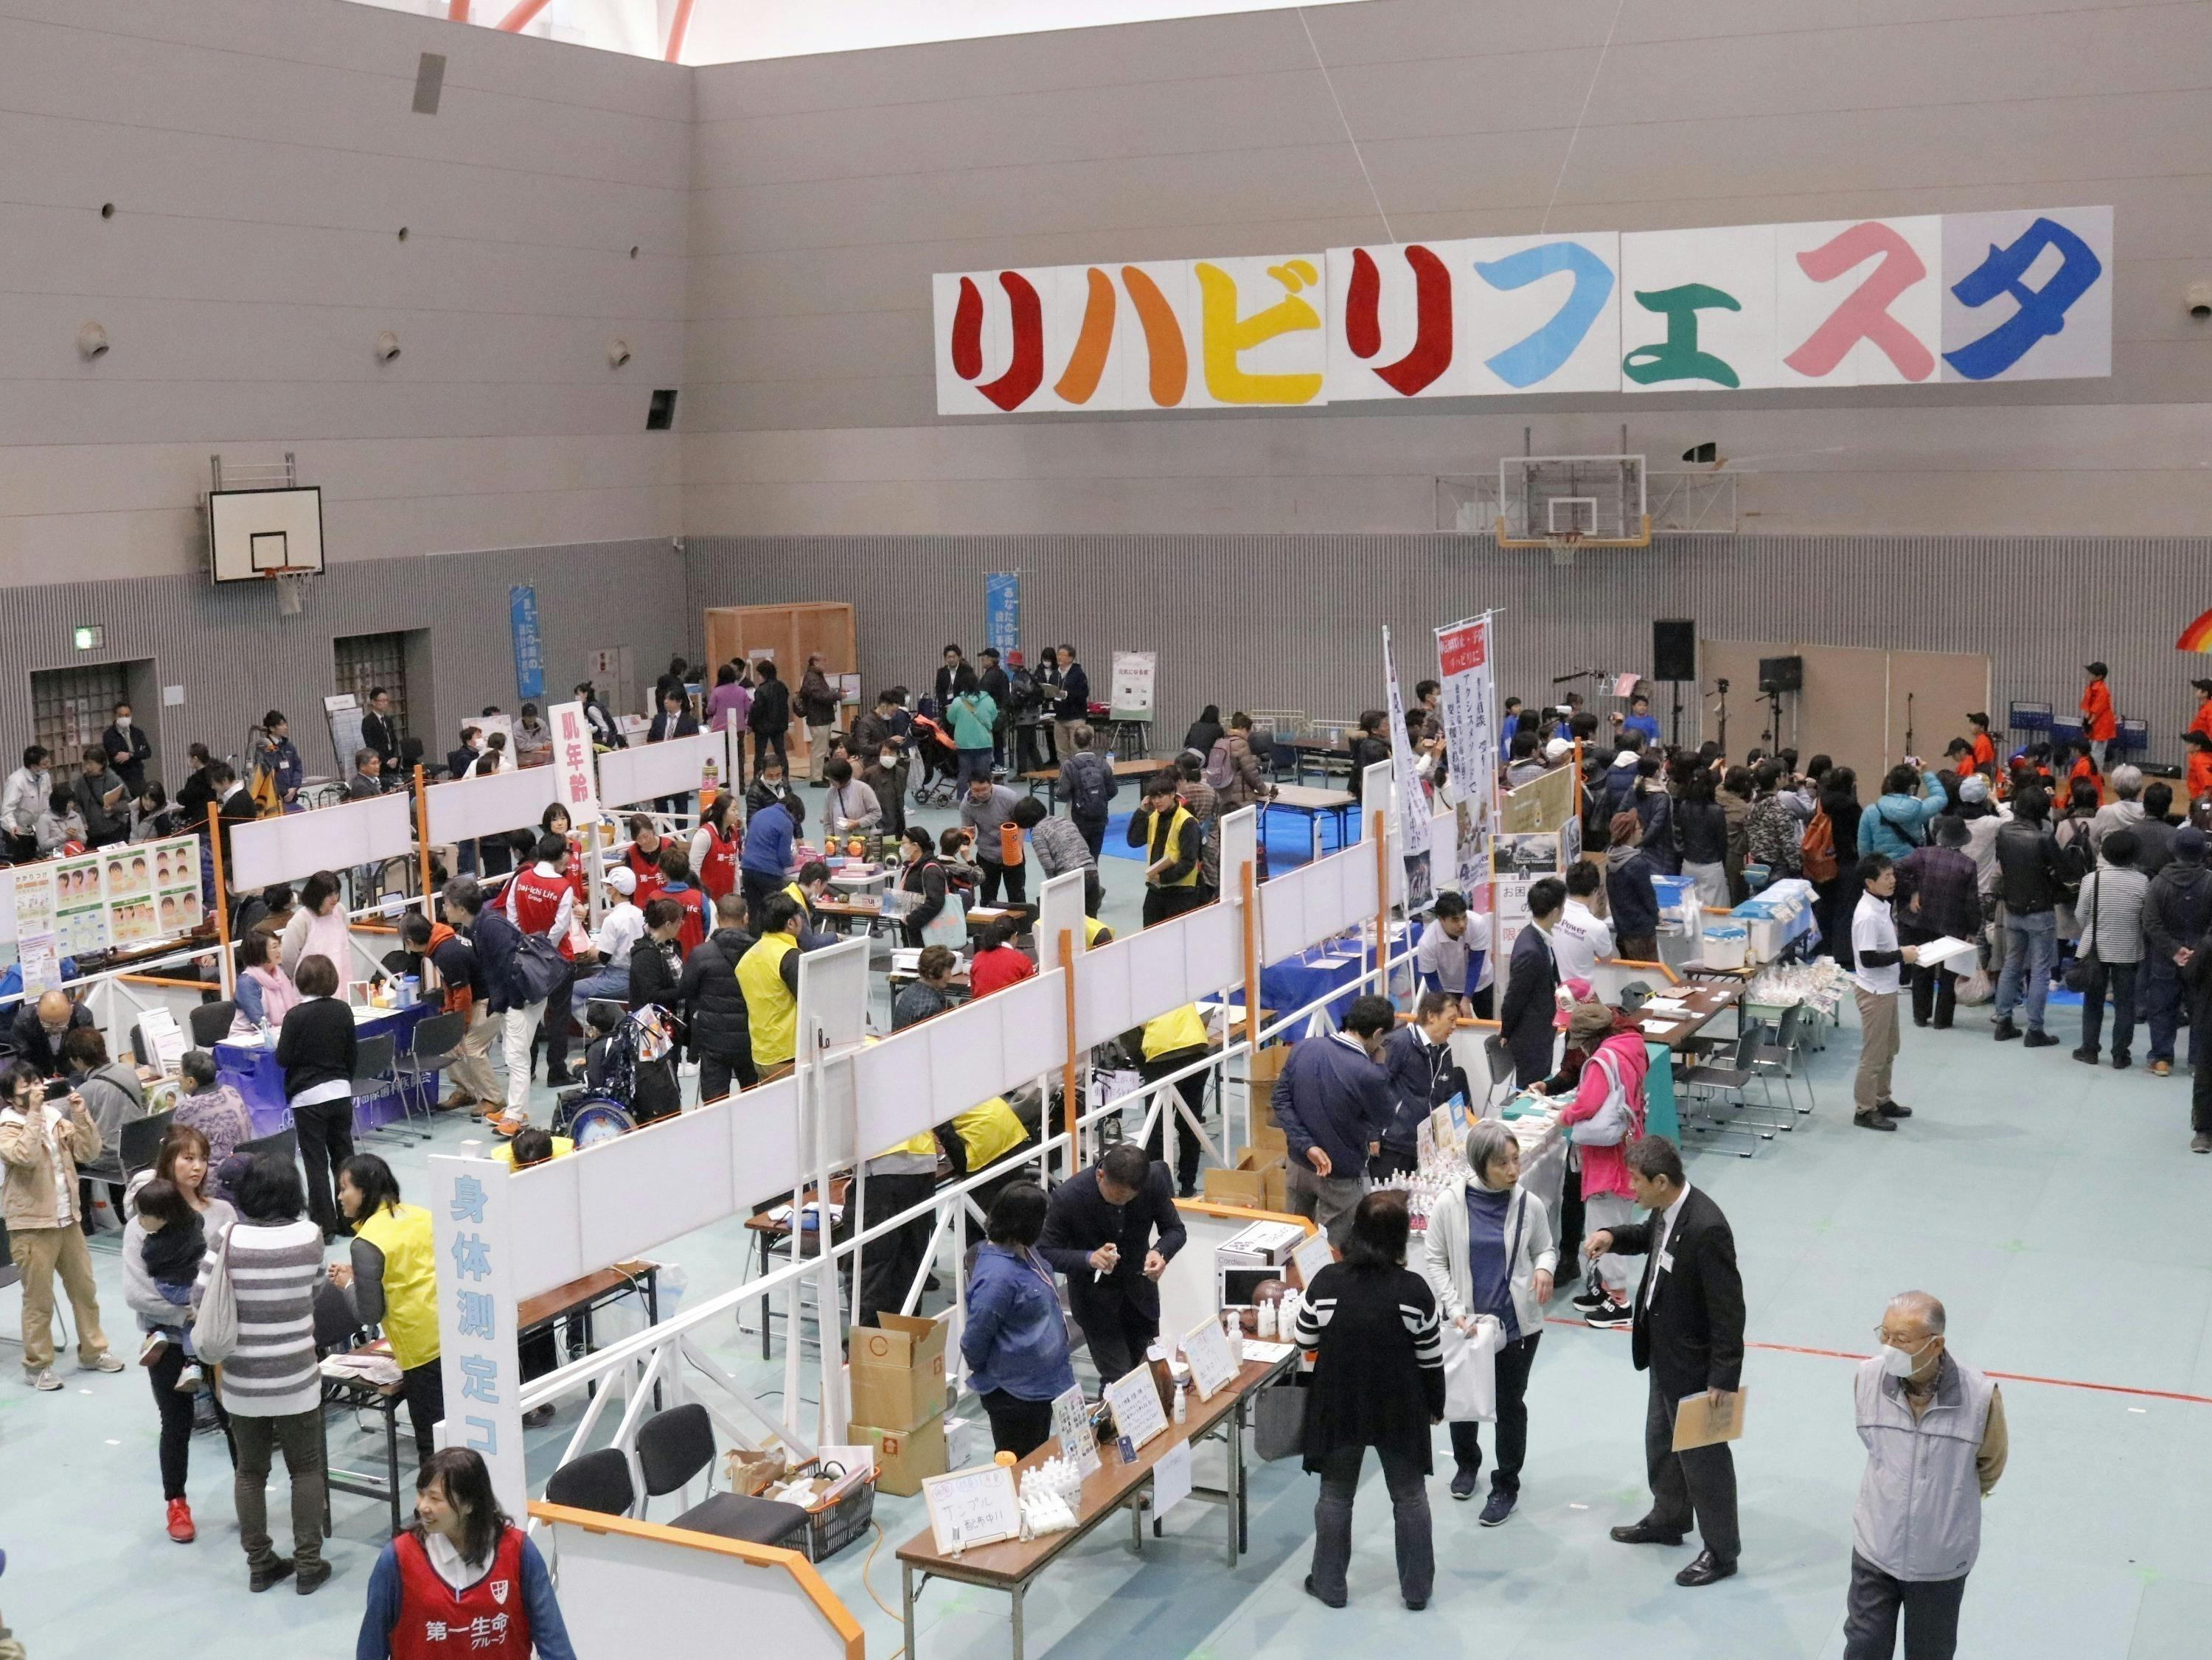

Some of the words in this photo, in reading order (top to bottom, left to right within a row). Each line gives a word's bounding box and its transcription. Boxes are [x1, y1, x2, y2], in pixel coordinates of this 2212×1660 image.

[952, 216, 2102, 411] リハビリフェスタ
[561, 711, 588, 803] 肌年齢
[528, 895, 543, 904] Group
[543, 890, 557, 902] Life
[942, 1497, 993, 1521] サンプル
[425, 1612, 509, 1642] 第一生命
[472, 1631, 507, 1650] グループ
